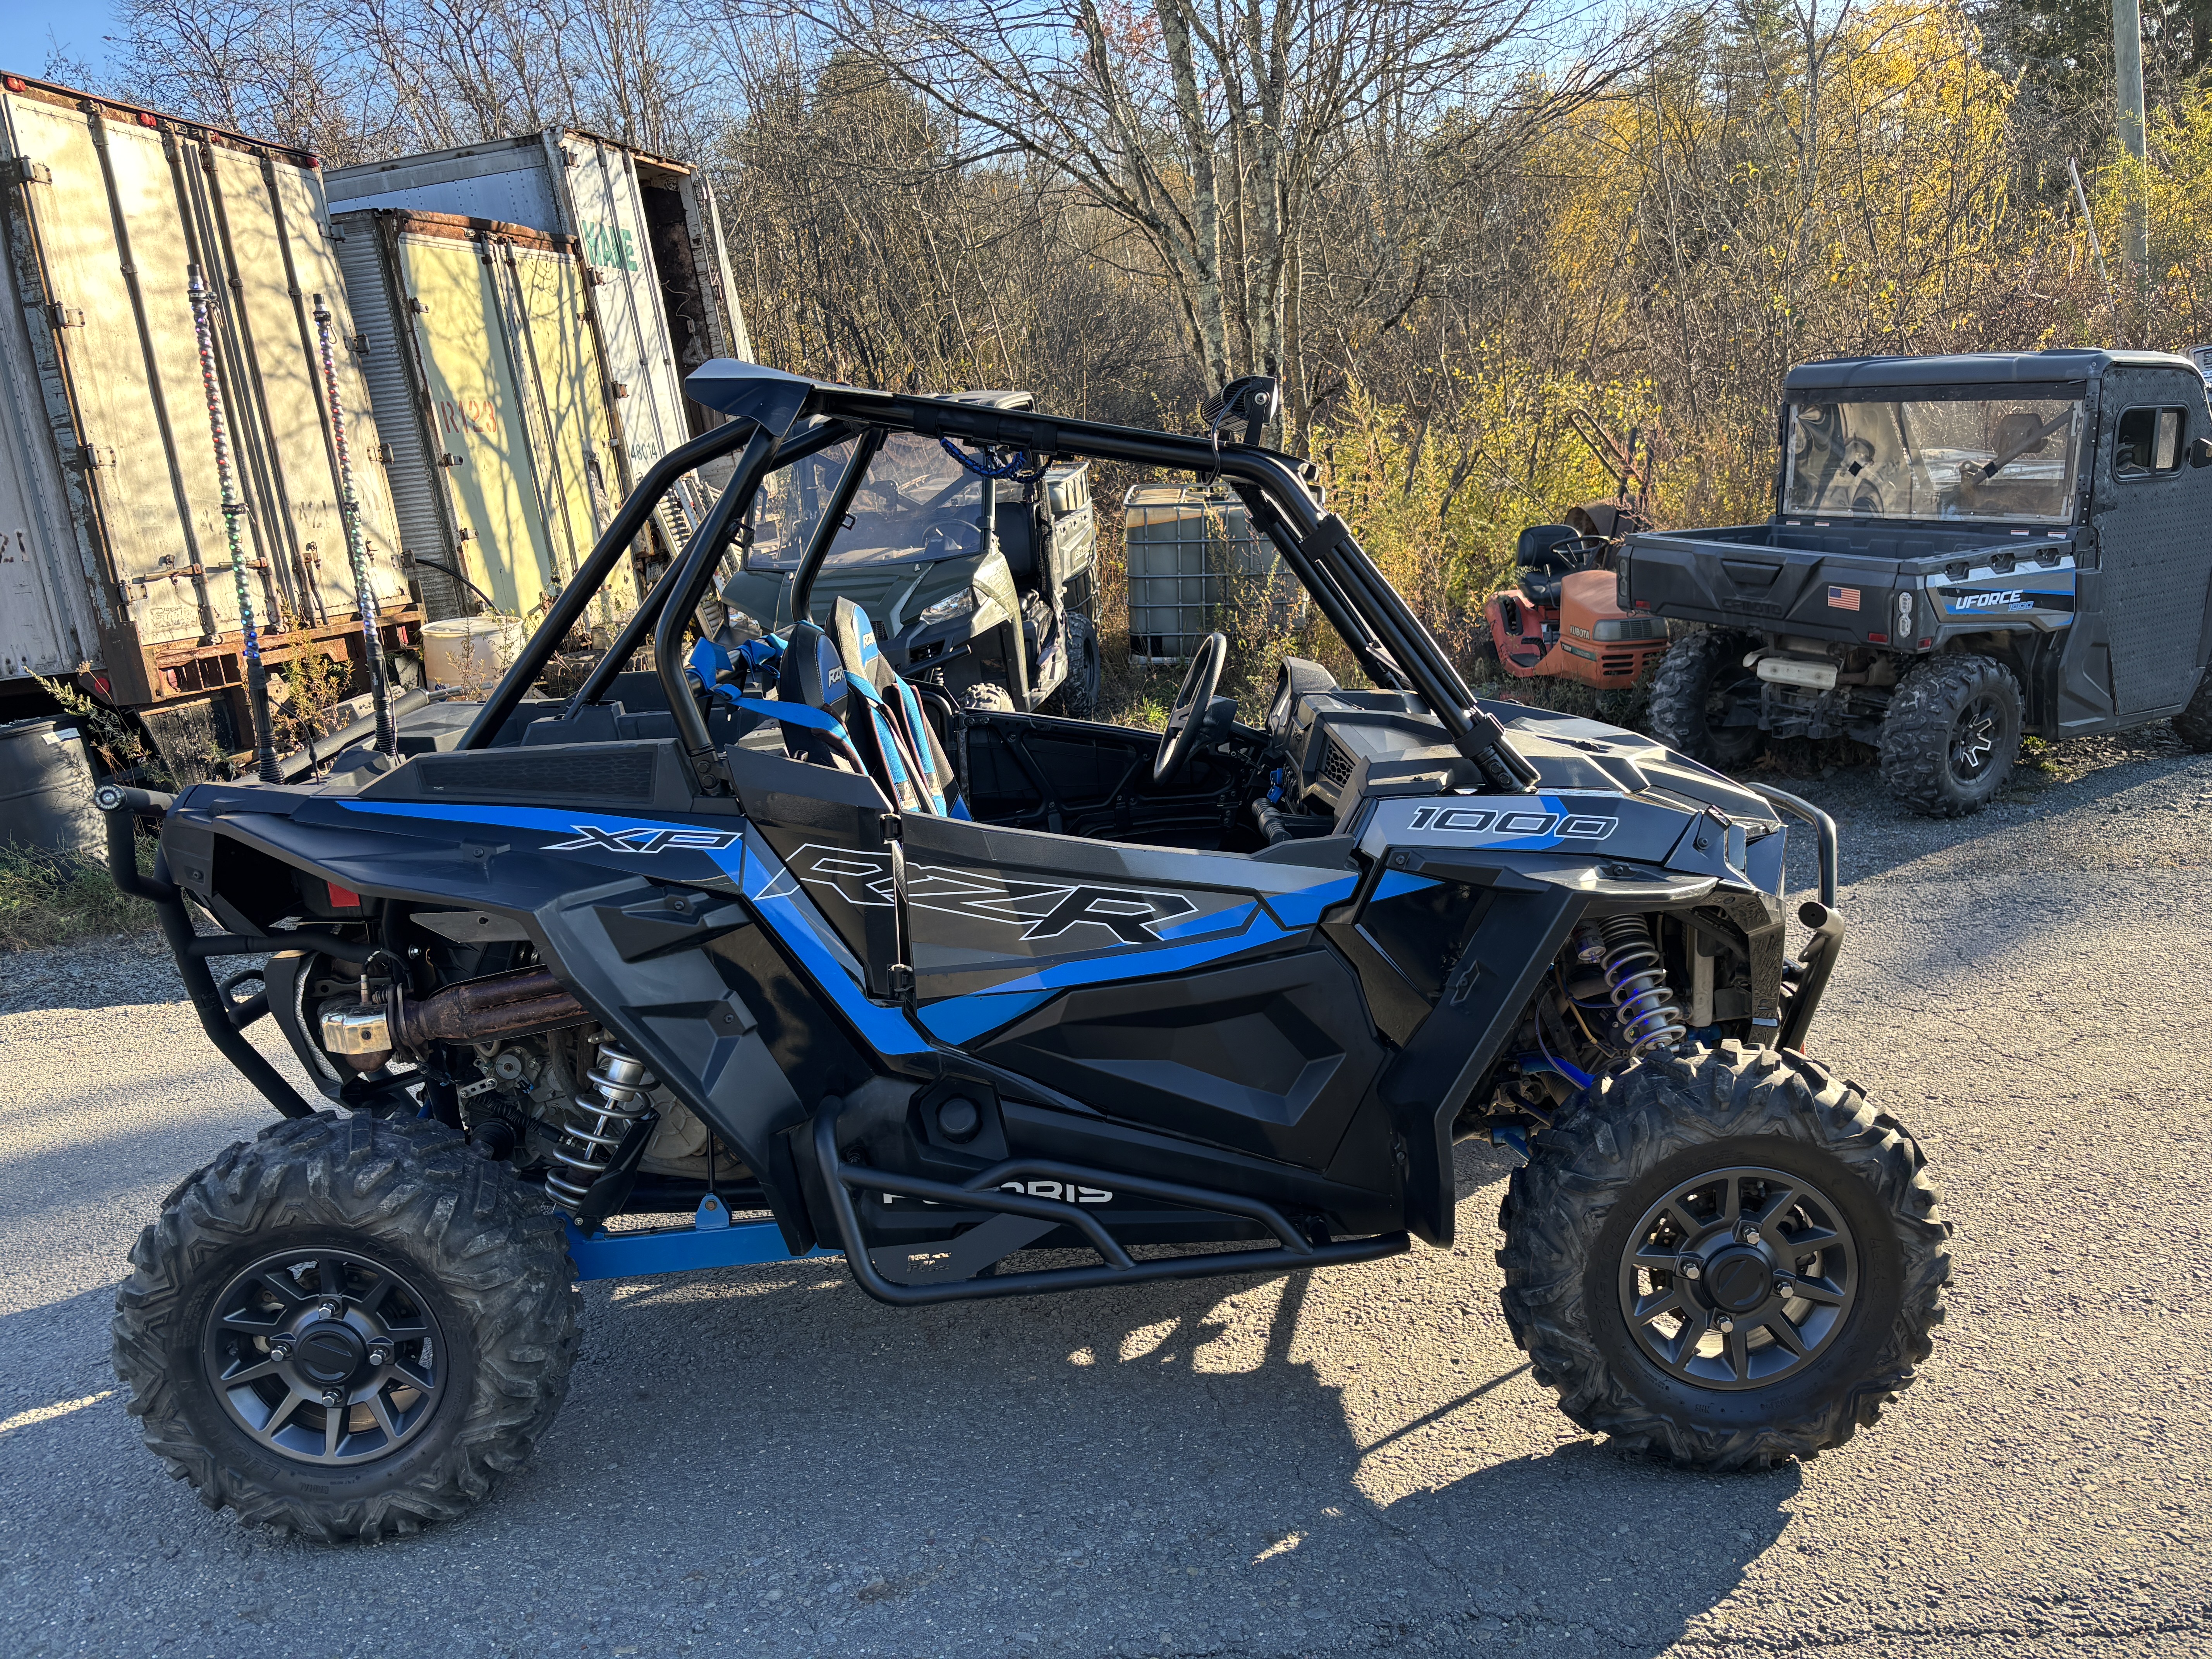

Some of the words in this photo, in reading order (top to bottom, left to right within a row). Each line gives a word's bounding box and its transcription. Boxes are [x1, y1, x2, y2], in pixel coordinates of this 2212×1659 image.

[440, 400, 496, 433] R123
[631, 442, 658, 461] 48014
[1956, 589, 2023, 610] UFORCE
[2008, 601, 2034, 612] 1000
[1570, 625, 1590, 640] KUBOTA
[828, 666, 845, 688] RZR
[1407, 806, 1619, 840] 1000
[538, 825, 743, 854] XP
[753, 843, 1199, 945] RZR
